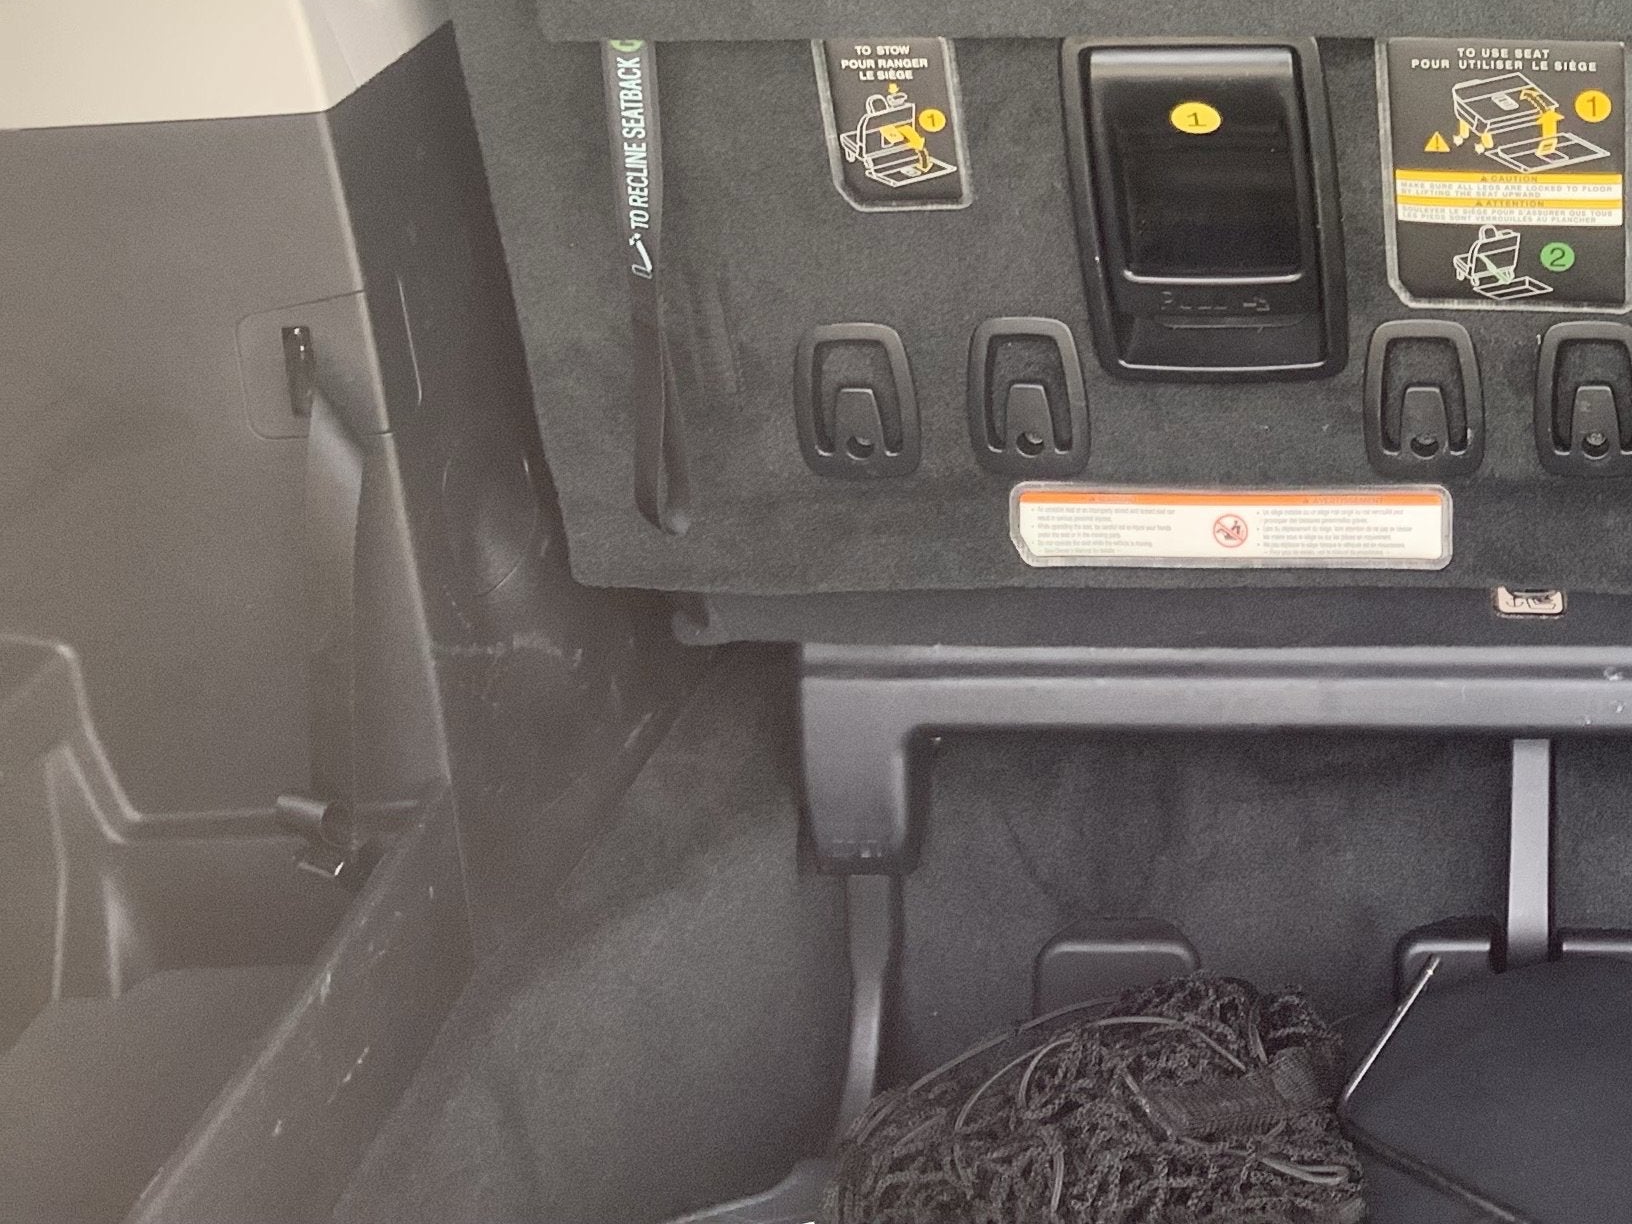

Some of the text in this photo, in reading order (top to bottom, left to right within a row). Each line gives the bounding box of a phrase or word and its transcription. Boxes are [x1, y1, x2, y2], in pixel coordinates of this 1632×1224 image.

[854, 45, 910, 55] TO STOW
[1457, 48, 1550, 59] TO USE SEAT
[841, 58, 928, 69] POUR RANGER
[1411, 59, 1597, 72] POUR UTILISER LE SIÈGE
[859, 68, 913, 80] LE SIÈGE
[616, 56, 646, 139] SEATBACK
[1586, 96, 1596, 117] 1
[1186, 112, 1207, 127] 1
[623, 142, 649, 208] RECLINE
[1491, 175, 1538, 183] CAUTION
[1486, 200, 1545, 208] ATTENTION
[629, 210, 649, 229] TO
[1550, 247, 1566, 267] 2
